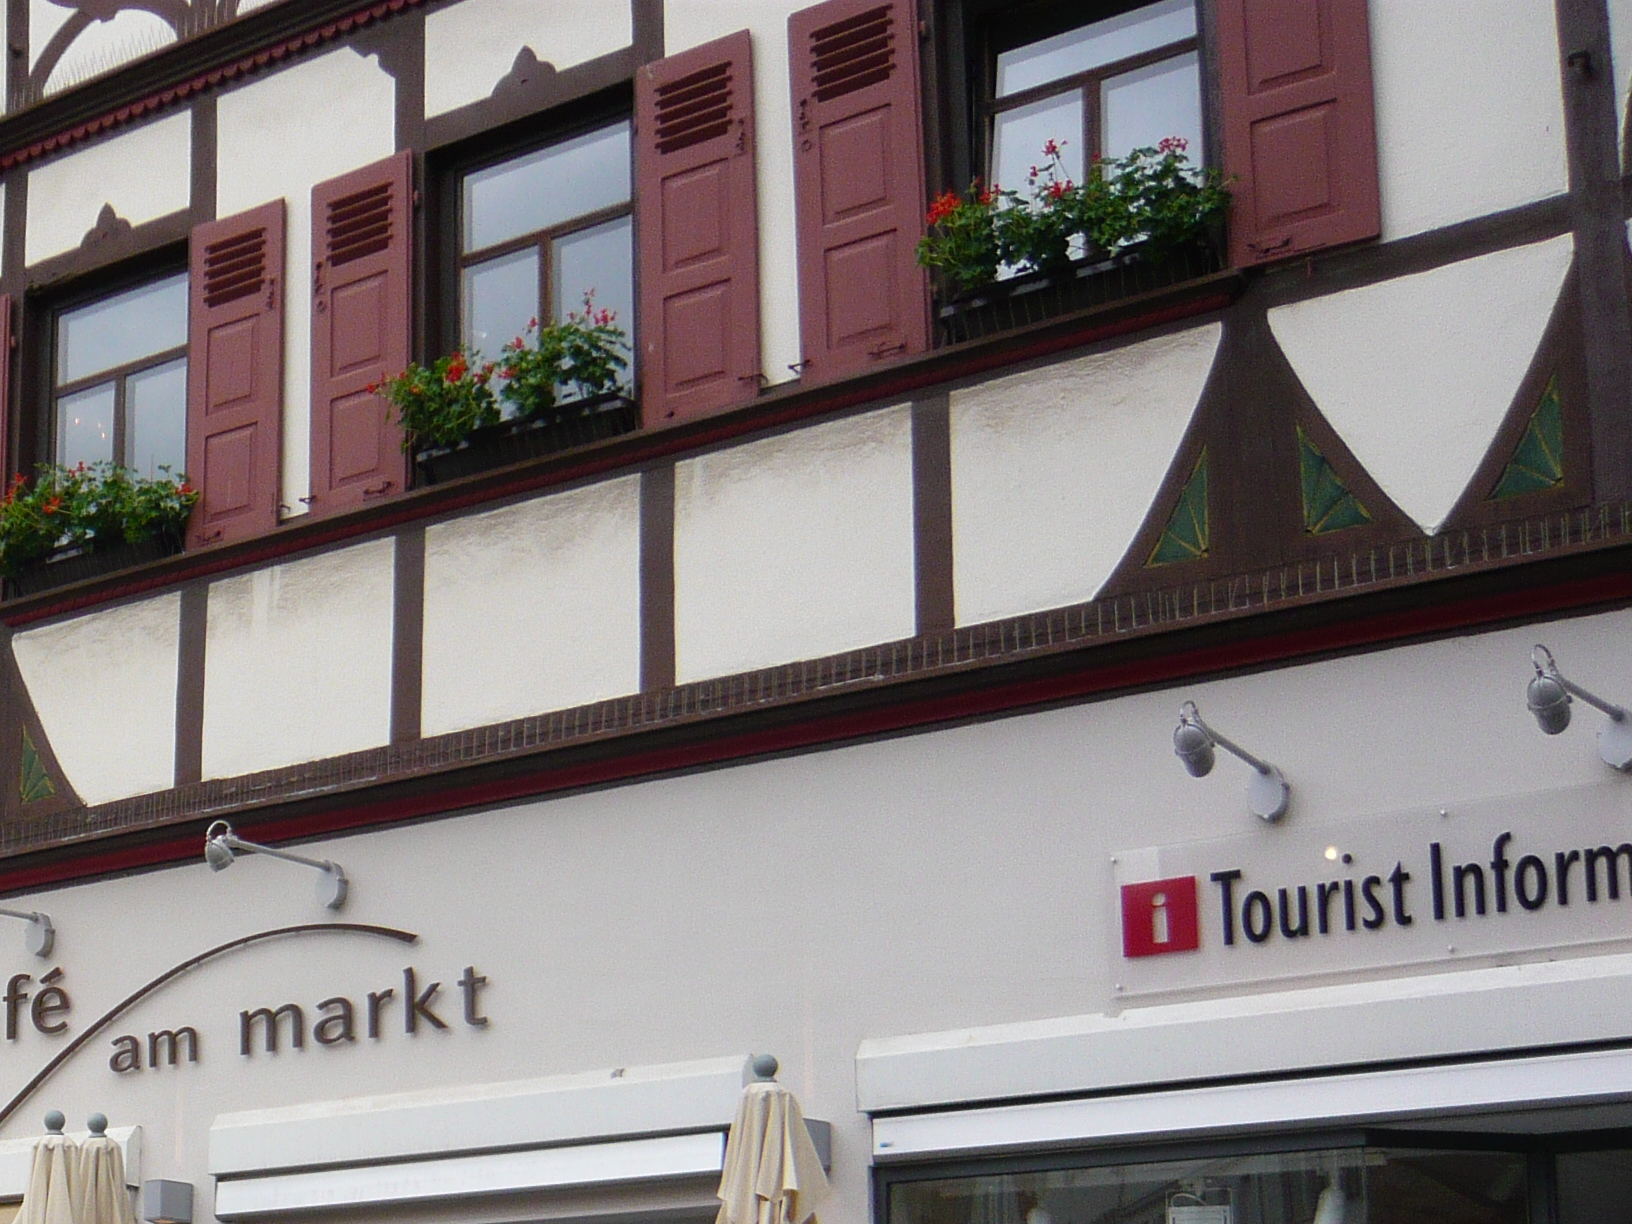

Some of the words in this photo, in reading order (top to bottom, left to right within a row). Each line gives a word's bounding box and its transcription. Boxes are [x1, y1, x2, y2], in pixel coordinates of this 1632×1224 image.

[1210, 861, 1412, 945] Tourist
[108, 1022, 199, 1074] am
[238, 965, 489, 1057] markt
